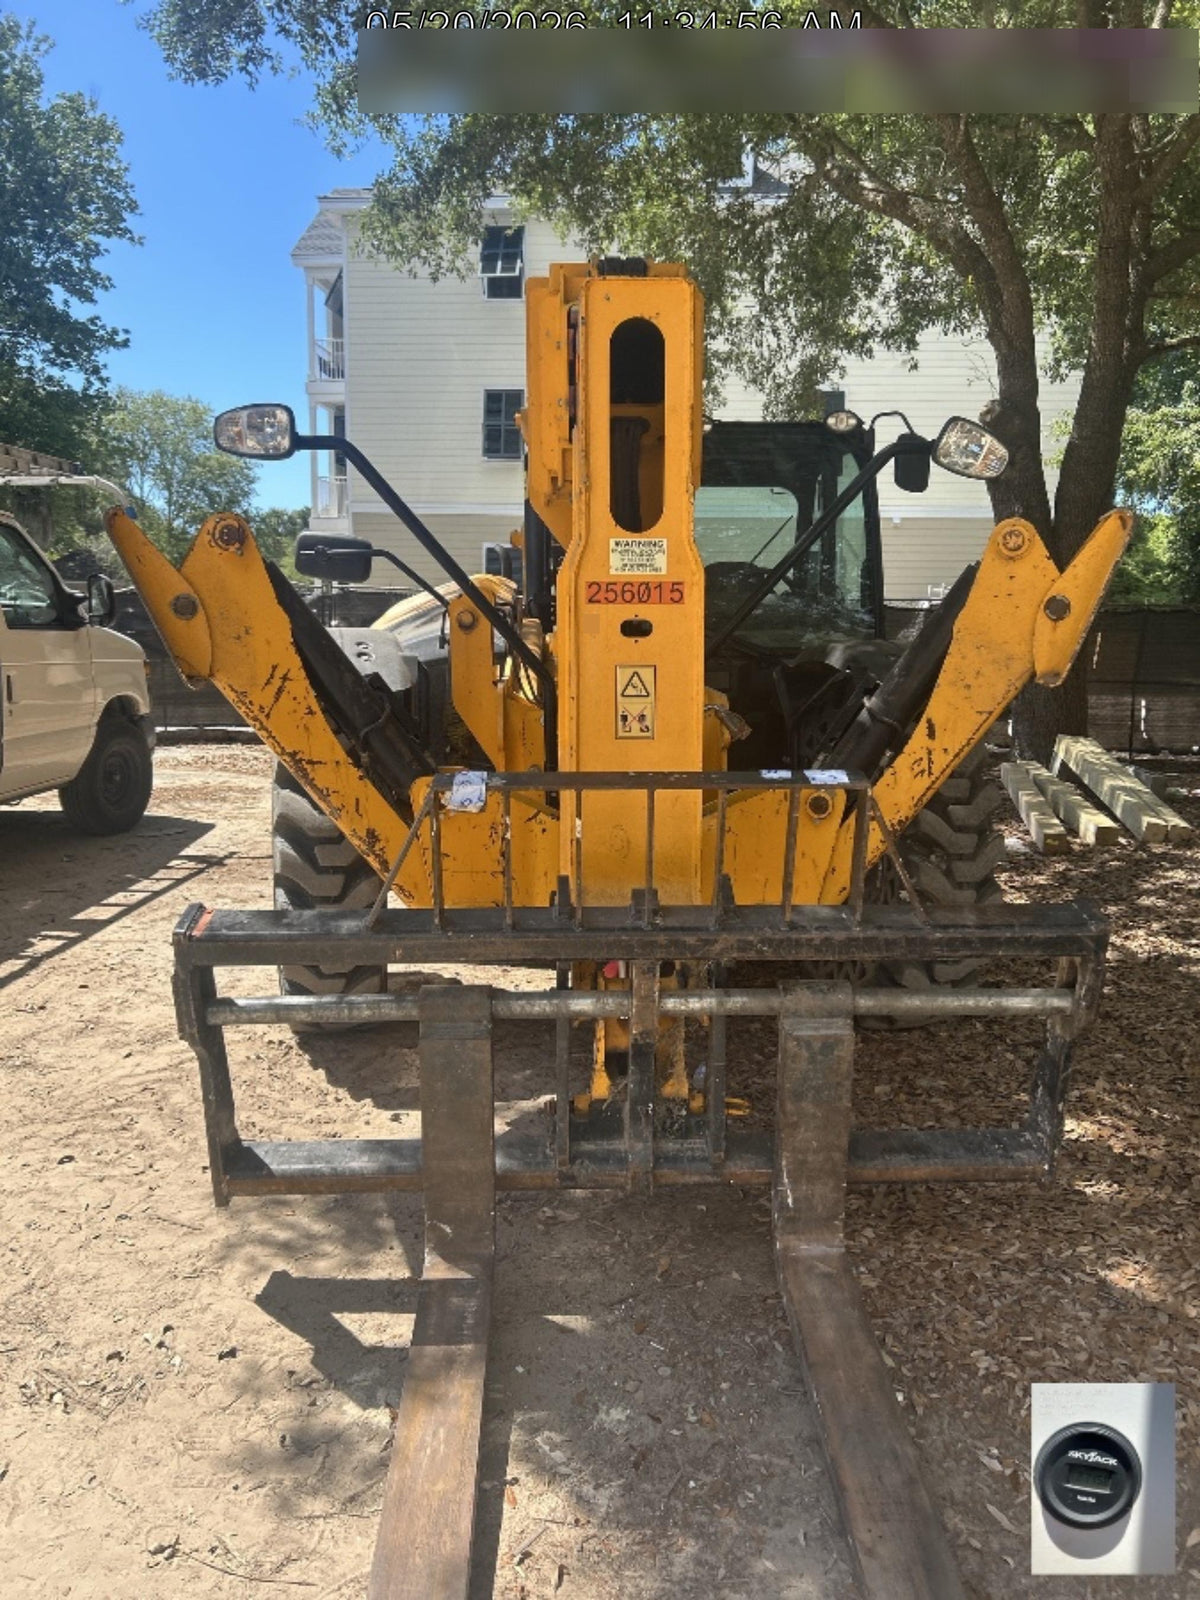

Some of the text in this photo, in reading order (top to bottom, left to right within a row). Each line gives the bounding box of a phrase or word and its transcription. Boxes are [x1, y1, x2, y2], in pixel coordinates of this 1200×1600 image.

[614, 540, 664, 548] WARNING
[587, 581, 684, 603] 256015
[1067, 1450, 1118, 1466] SKYJACK
